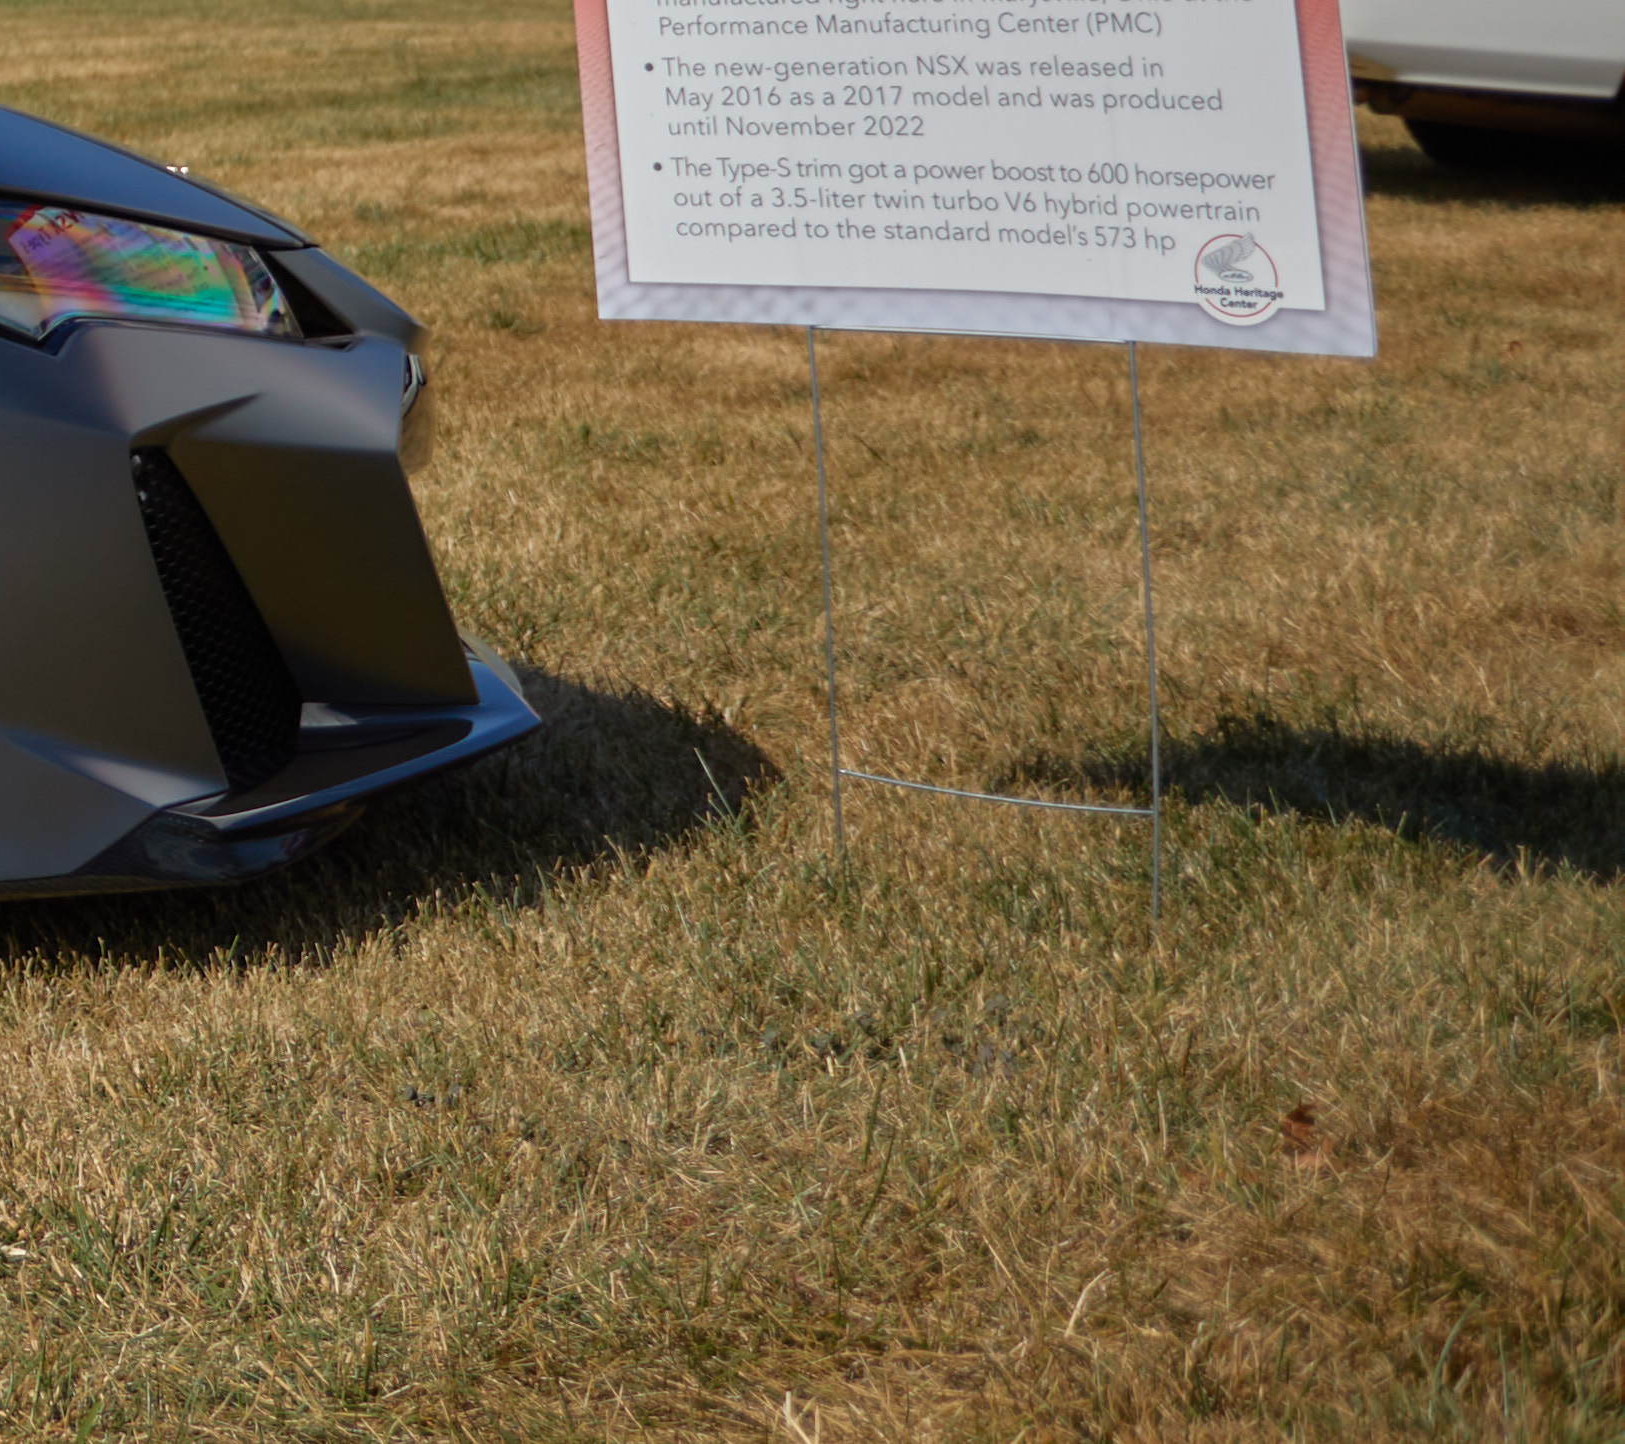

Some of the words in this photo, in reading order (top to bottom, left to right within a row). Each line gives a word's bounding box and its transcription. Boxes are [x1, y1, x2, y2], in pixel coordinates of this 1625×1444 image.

[658, 14, 808, 36] Performance
[815, 11, 991, 39] Manufacturing
[997, 11, 1079, 33] Center
[1086, 11, 1162, 37] (PMC)
[661, 56, 706, 77] The
[714, 56, 908, 82] new-generation
[915, 54, 969, 76] NSX
[975, 61, 1022, 76] was
[1029, 55, 1134, 77] released
[1142, 57, 1164, 77] in
[665, 86, 713, 112] May
[721, 85, 782, 106] 2016
[789, 91, 815, 106] as
[822, 91, 835, 106] a
[842, 84, 902, 106] 2017
[912, 85, 990, 106] model
[997, 86, 1043, 108] and
[1049, 93, 1095, 108] was
[1102, 87, 1223, 115] produced
[668, 115, 718, 136] until
[725, 115, 856, 136] November
[863, 115, 924, 137] 2022
[669, 156, 712, 177] The
[715, 157, 791, 183] Type-S
[795, 158, 842, 178] trim
[847, 162, 888, 184] got
[893, 164, 907, 179] a
[912, 164, 986, 185] power
[990, 159, 1055, 182] boost
[1058, 165, 1082, 183] to
[1087, 162, 1129, 185] 600
[1134, 163, 1275, 194] horsepower
[673, 191, 712, 207] out
[719, 185, 742, 207] of
[750, 193, 763, 208] a
[771, 186, 866, 209] 3.5-liter
[872, 189, 925, 209] twin
[931, 189, 999, 211] turbo
[1004, 191, 1037, 213] V6
[1043, 192, 1118, 220] hybrid
[1126, 200, 1260, 222] powertrain
[675, 217, 797, 242] compared
[803, 221, 830, 239] to
[835, 218, 876, 240] the
[883, 220, 991, 242] standard
[998, 223, 1088, 246] model's
[1094, 225, 1136, 249] 573
[1144, 228, 1176, 257] hp
[1194, 284, 1231, 296] Honda
[1234, 286, 1284, 301] Heritage
[1220, 297, 1258, 309] Center
